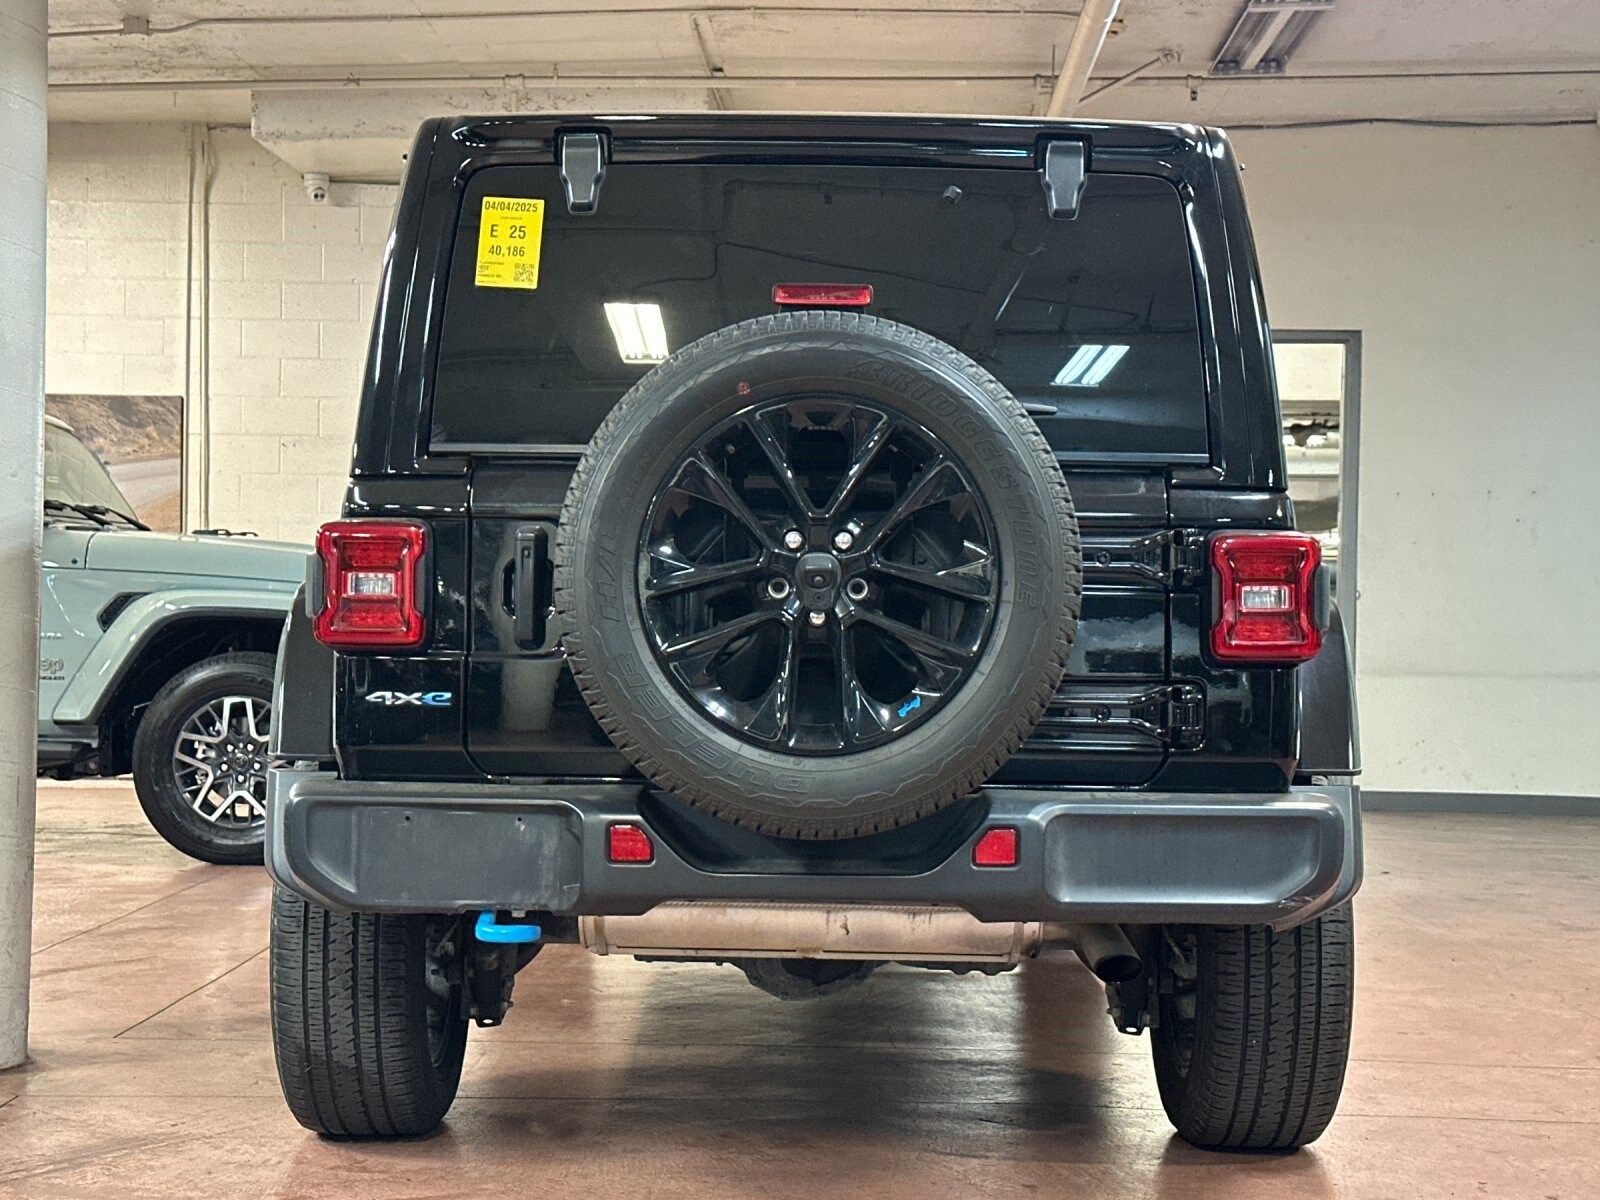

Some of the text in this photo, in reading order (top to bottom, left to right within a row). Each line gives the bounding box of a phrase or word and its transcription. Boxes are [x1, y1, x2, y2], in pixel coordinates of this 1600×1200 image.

[484, 200, 538, 213] 04/04/2025
[490, 223, 527, 240] E 25
[488, 244, 526, 257] 40,186
[845, 355, 1040, 610] BRIDGESTONE
[40, 658, 64, 675] ep
[614, 651, 819, 795] DUELER
